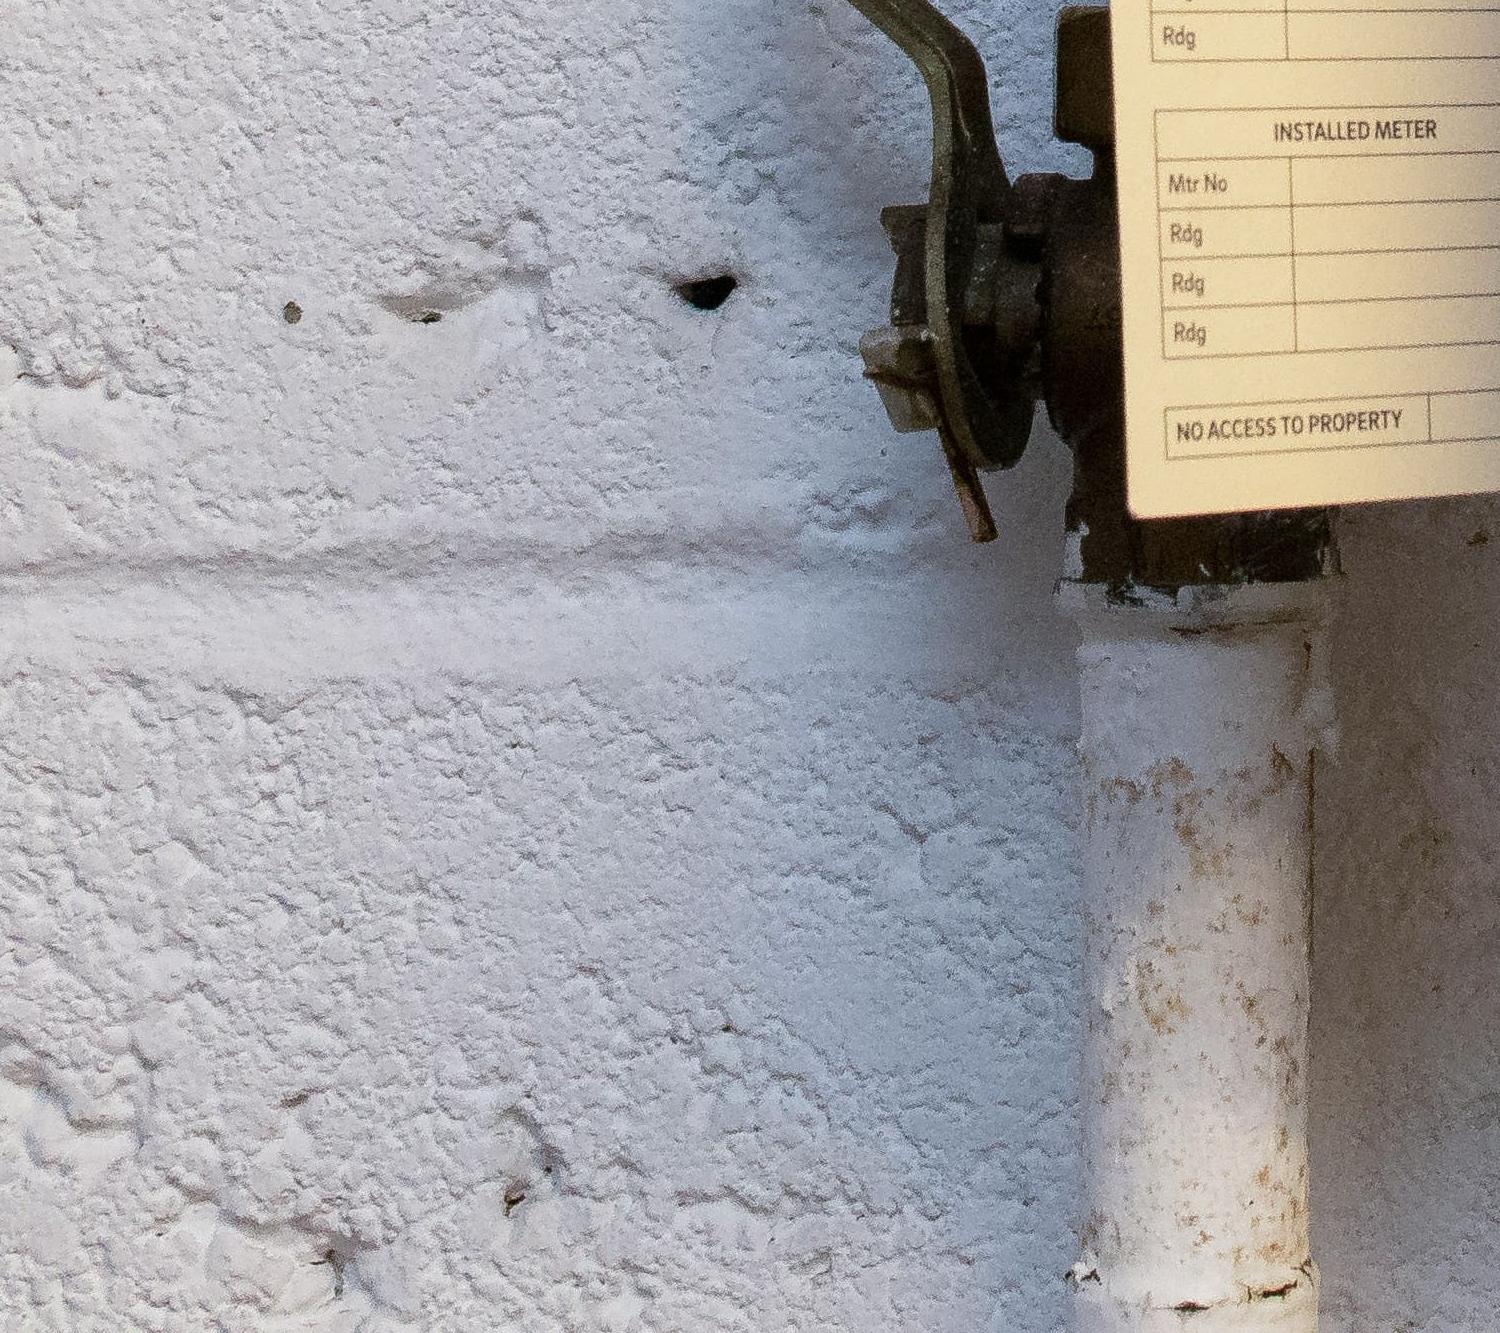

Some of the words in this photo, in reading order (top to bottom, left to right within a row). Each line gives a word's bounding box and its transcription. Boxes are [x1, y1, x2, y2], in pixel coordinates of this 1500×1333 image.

[1163, 26, 1197, 50] Rdg
[1273, 121, 1371, 142] INSTALLED
[1374, 119, 1438, 140] METER
[1168, 174, 1200, 193] Mtr
[1203, 173, 1228, 192] No
[1170, 223, 1204, 247] Rdg
[1171, 272, 1205, 296] Rdg
[1173, 321, 1207, 346] Rdg
[1177, 422, 1205, 442] NO
[1207, 418, 1277, 440] ACCESS
[1280, 416, 1305, 435] TO
[1308, 410, 1403, 433] PROPERTY
